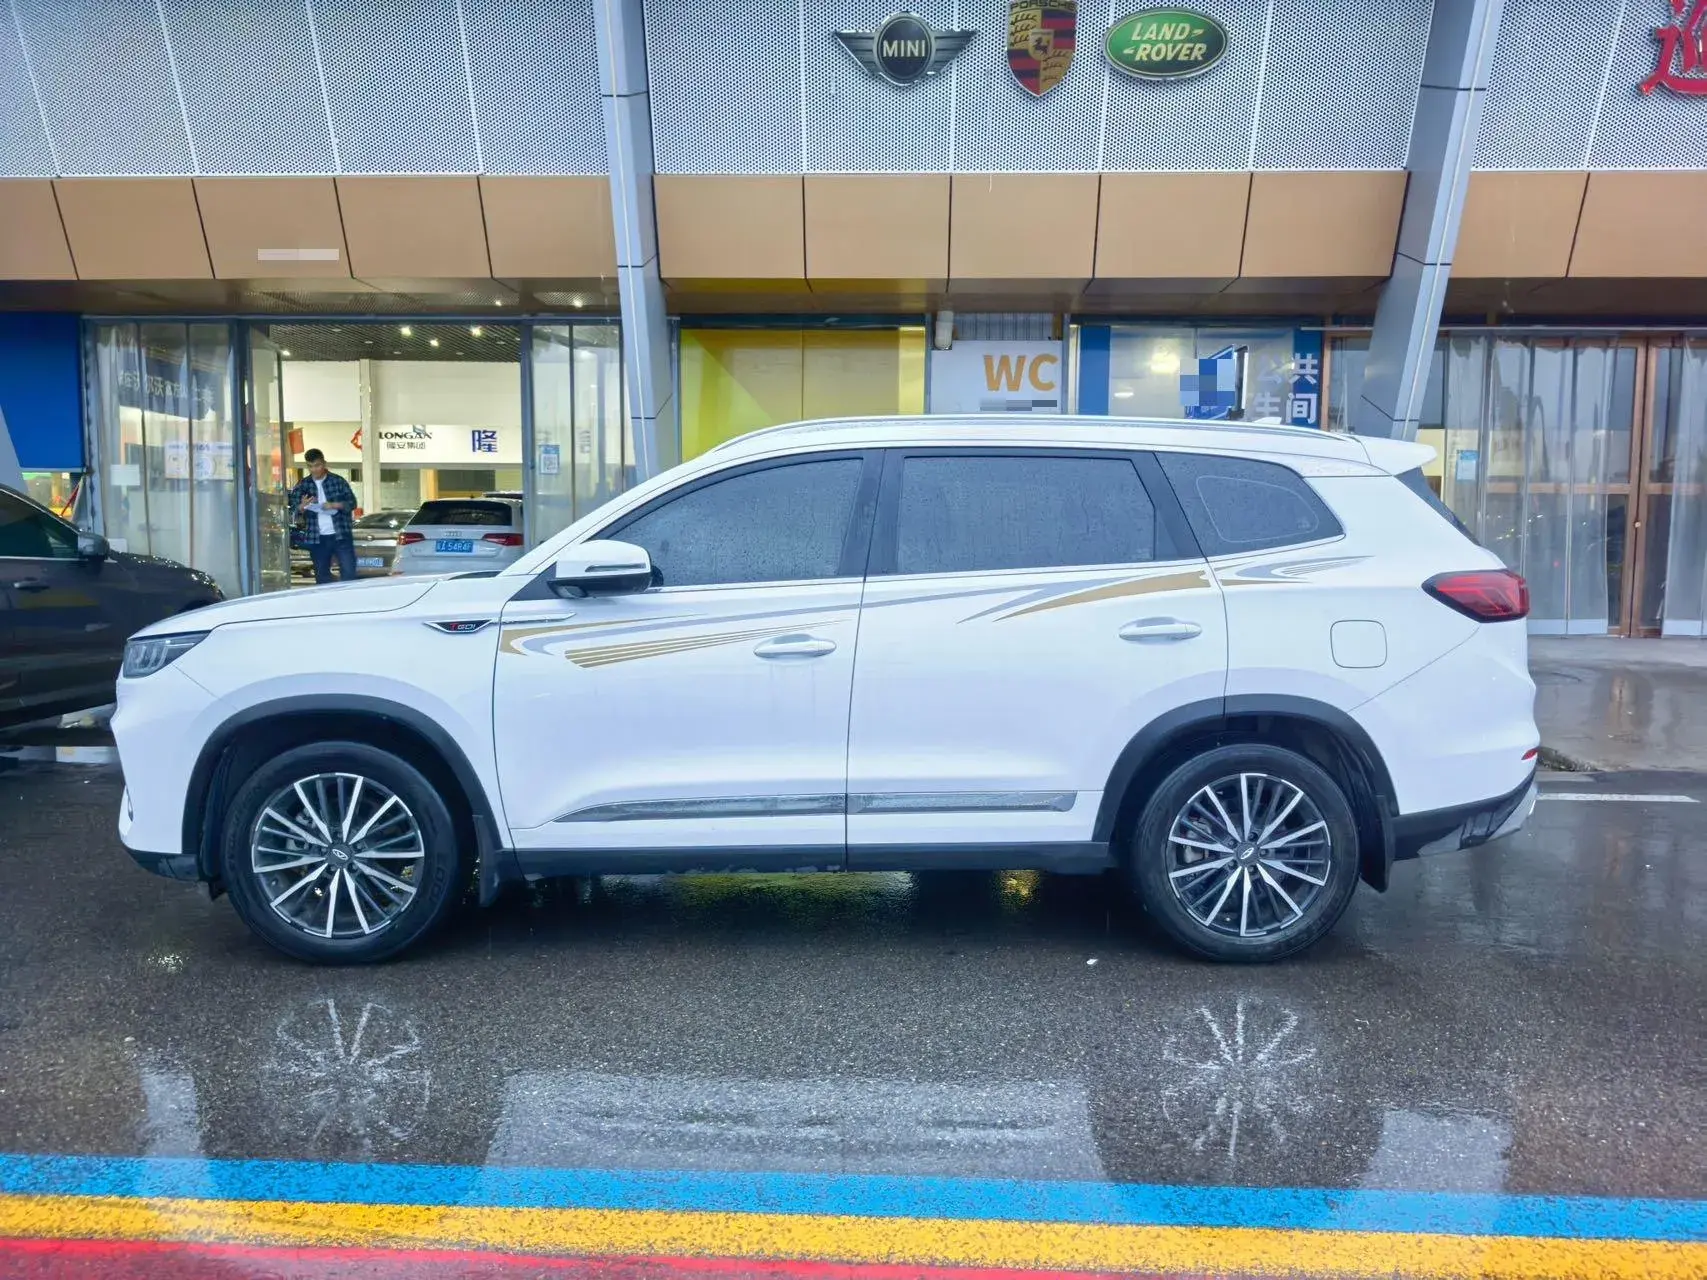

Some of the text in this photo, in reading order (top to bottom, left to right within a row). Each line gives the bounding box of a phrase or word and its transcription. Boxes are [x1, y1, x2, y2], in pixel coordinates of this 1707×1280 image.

[1131, 22, 1192, 42] LAND
[882, 39, 927, 59] MINI
[1134, 42, 1207, 62] ROVER
[983, 353, 1059, 392] WC
[378, 431, 433, 440] LONGAN
[471, 429, 498, 452] 隆
